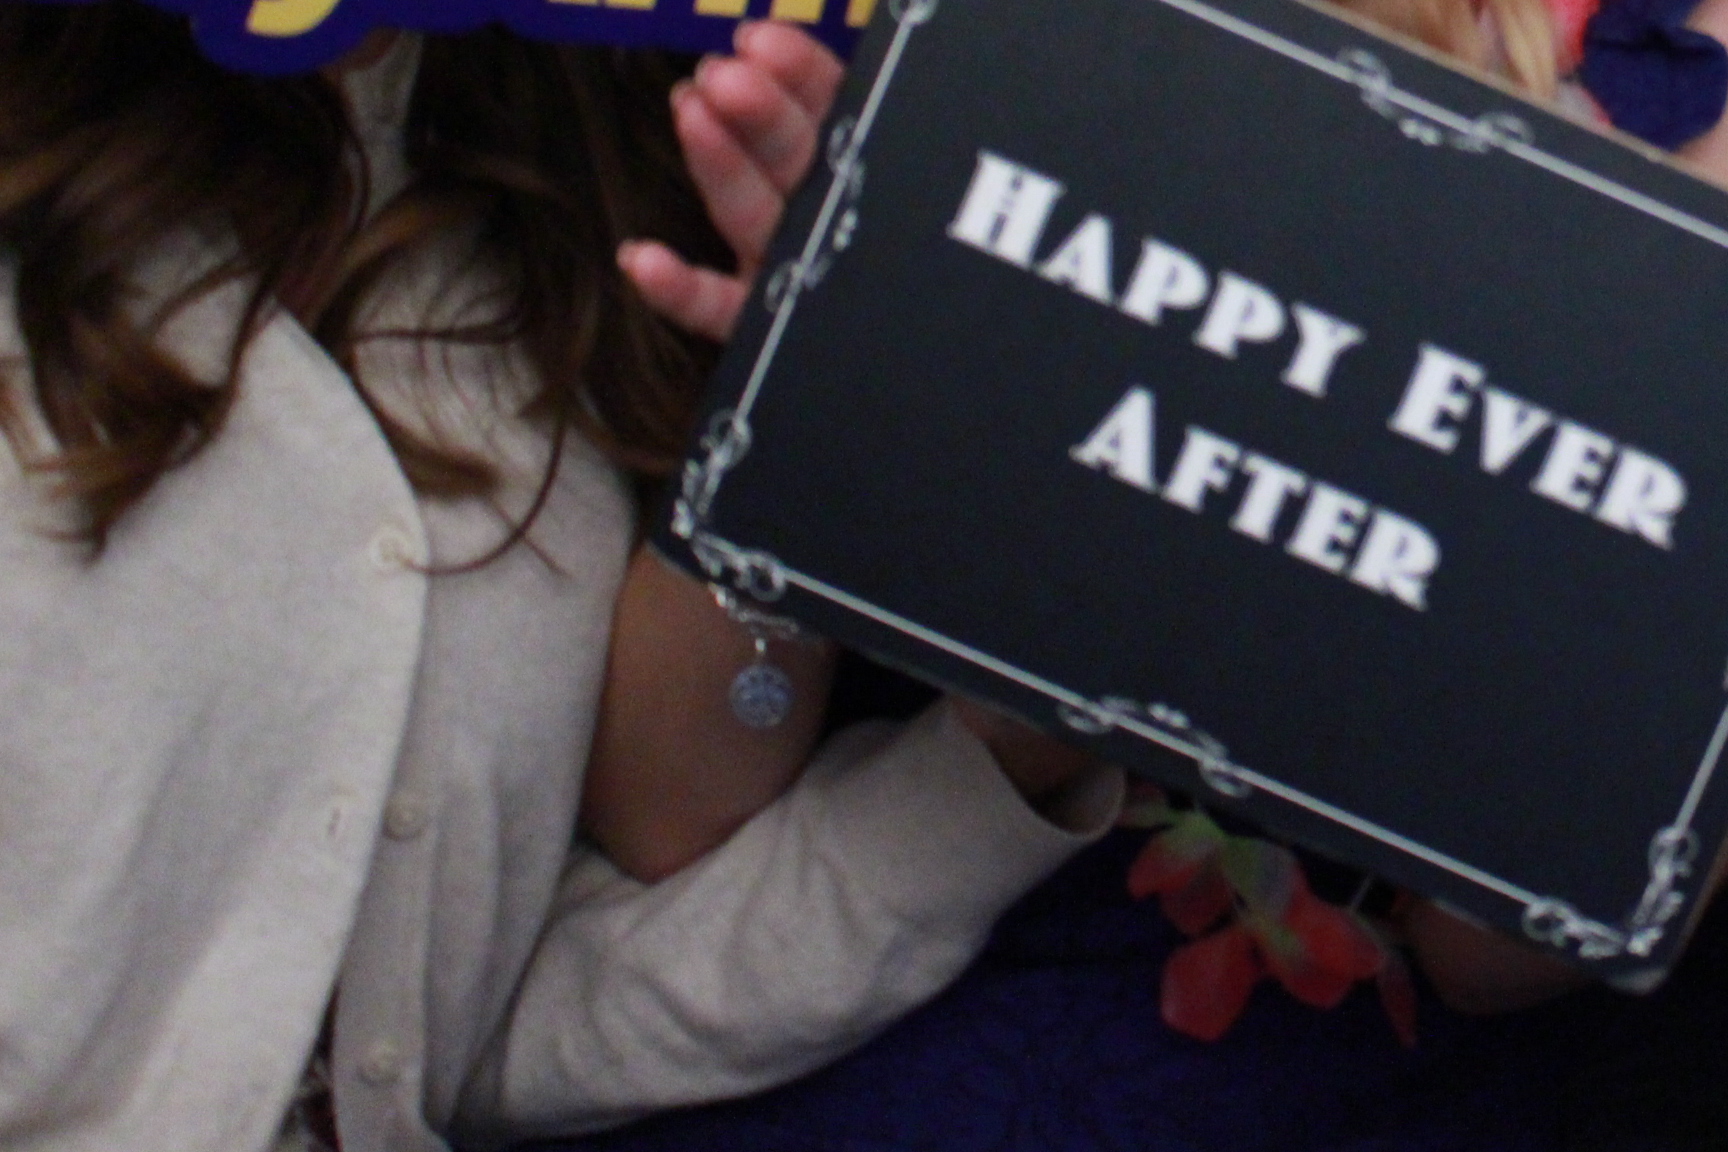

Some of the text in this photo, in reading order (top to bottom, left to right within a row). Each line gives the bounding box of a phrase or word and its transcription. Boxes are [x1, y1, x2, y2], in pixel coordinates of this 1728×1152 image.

[947, 149, 1688, 550] HAPPY EVER
[1070, 385, 1442, 610] AFTER
